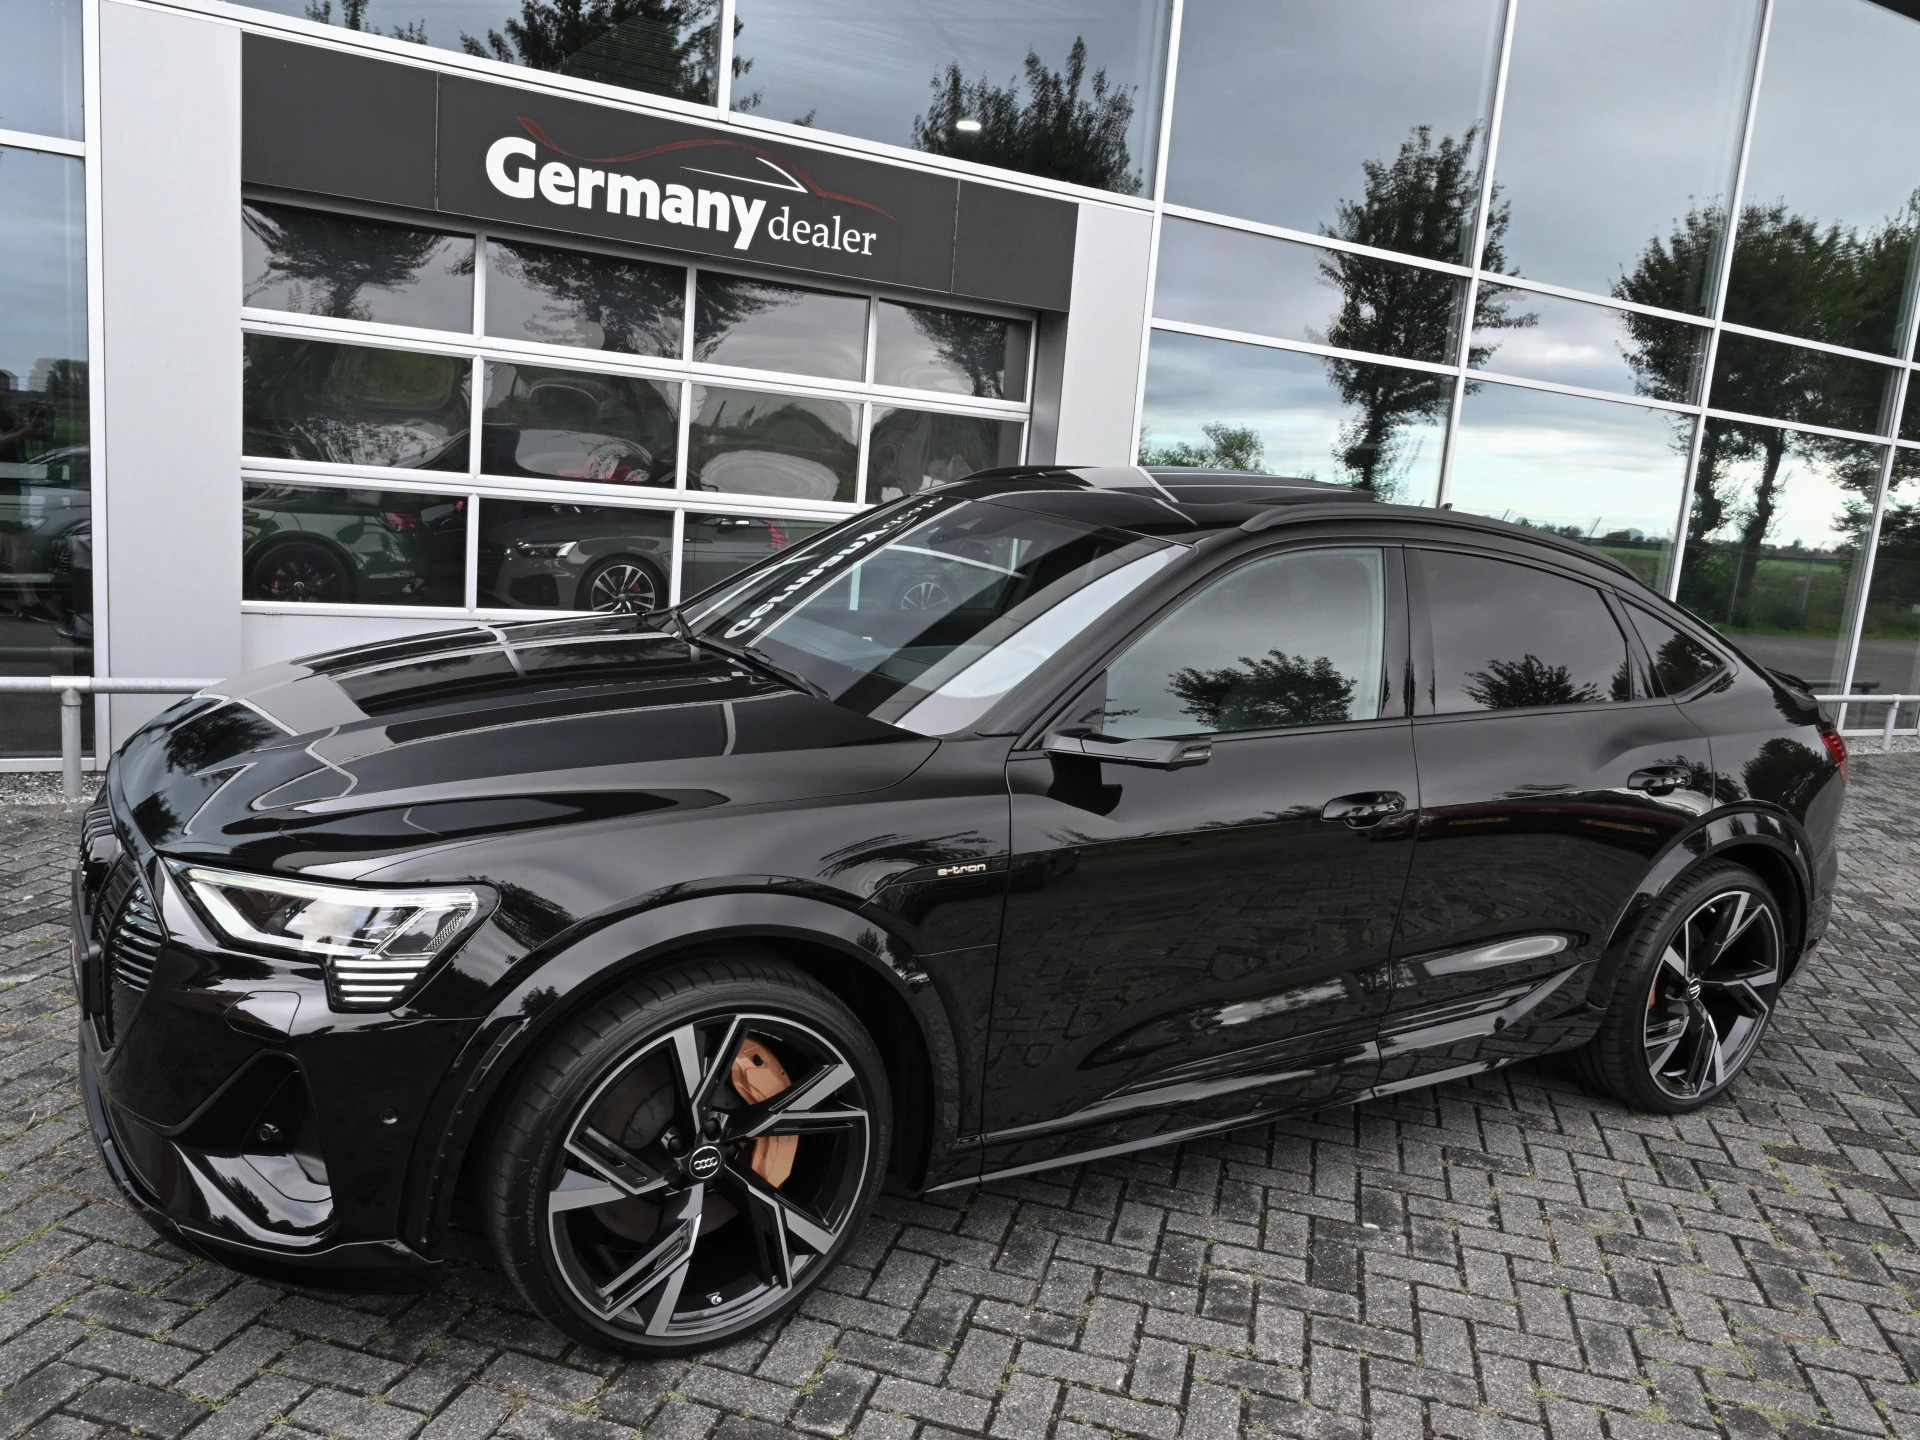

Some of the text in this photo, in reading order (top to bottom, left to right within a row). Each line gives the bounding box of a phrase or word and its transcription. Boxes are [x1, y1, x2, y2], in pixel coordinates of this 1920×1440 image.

[486, 136, 877, 256] Germany dealer
[937, 863, 987, 876] e-tron
